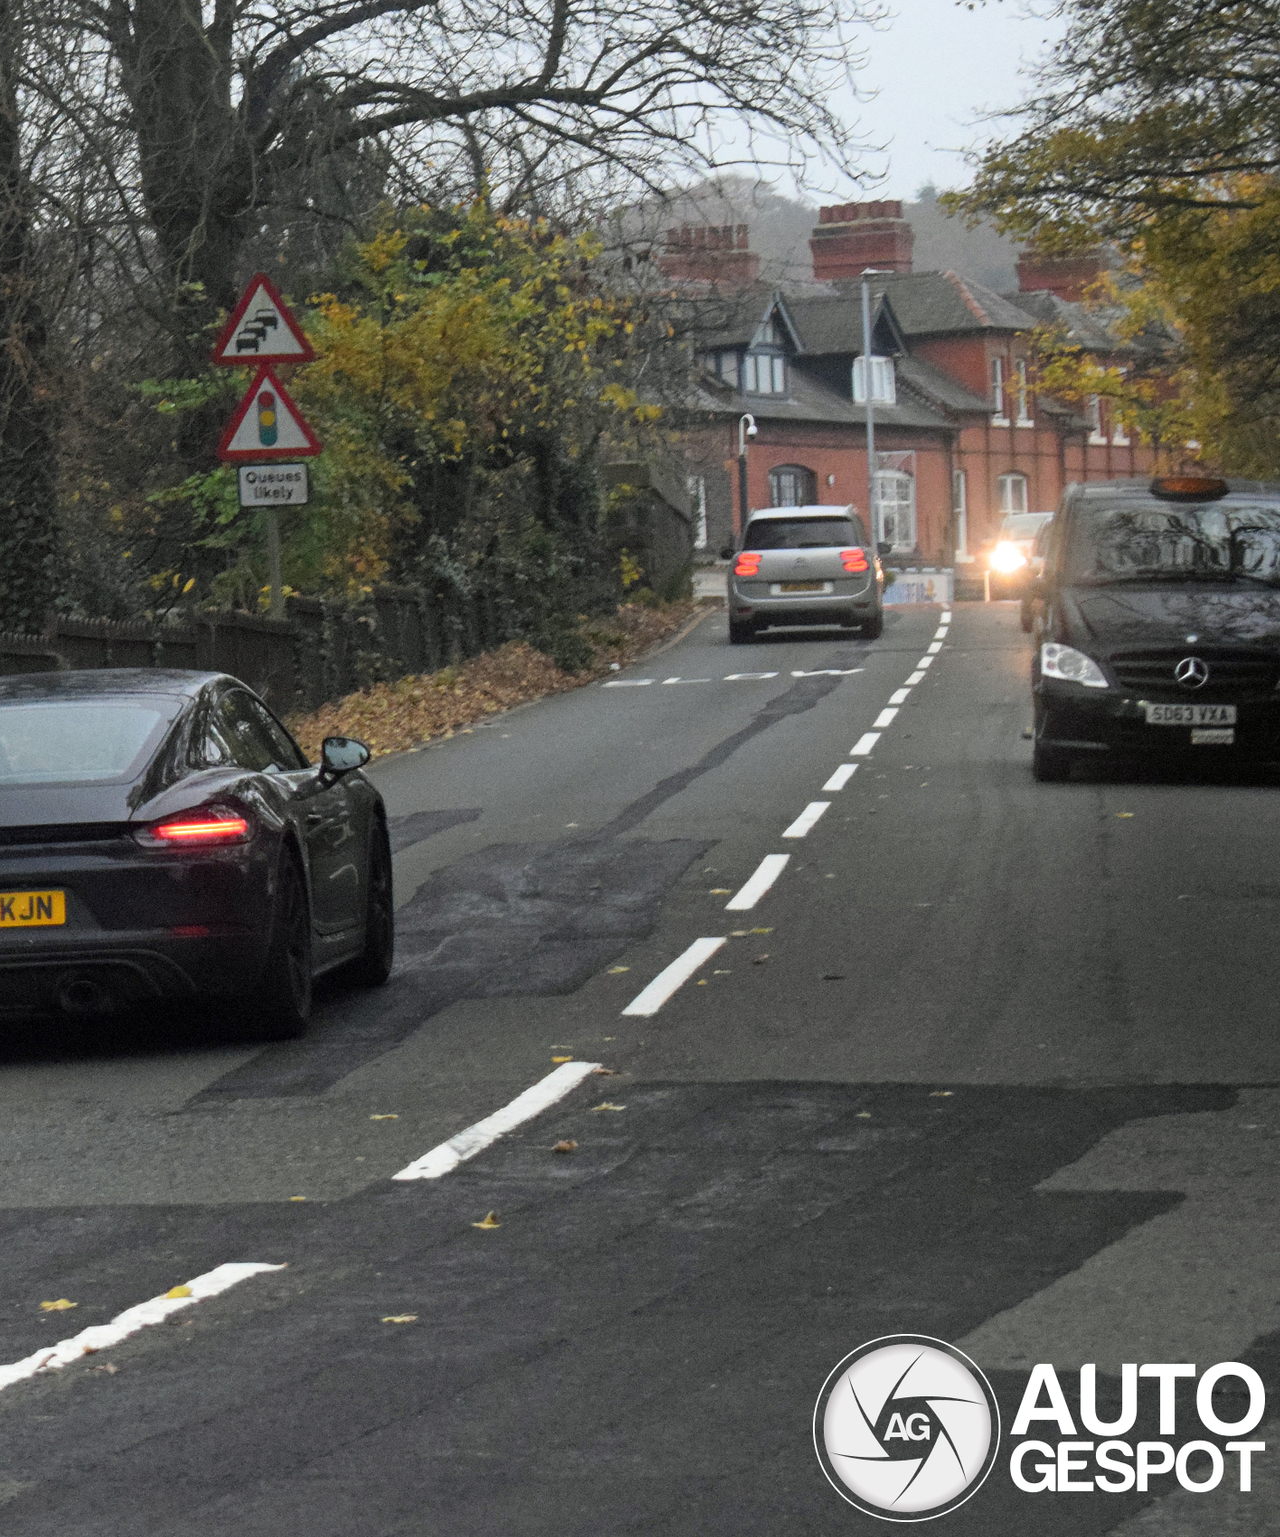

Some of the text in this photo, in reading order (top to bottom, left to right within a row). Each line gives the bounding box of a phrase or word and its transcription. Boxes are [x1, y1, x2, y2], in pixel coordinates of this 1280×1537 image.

[246, 471, 302, 484] Queues
[254, 485, 294, 500] likely
[0, 895, 53, 921] KJN
